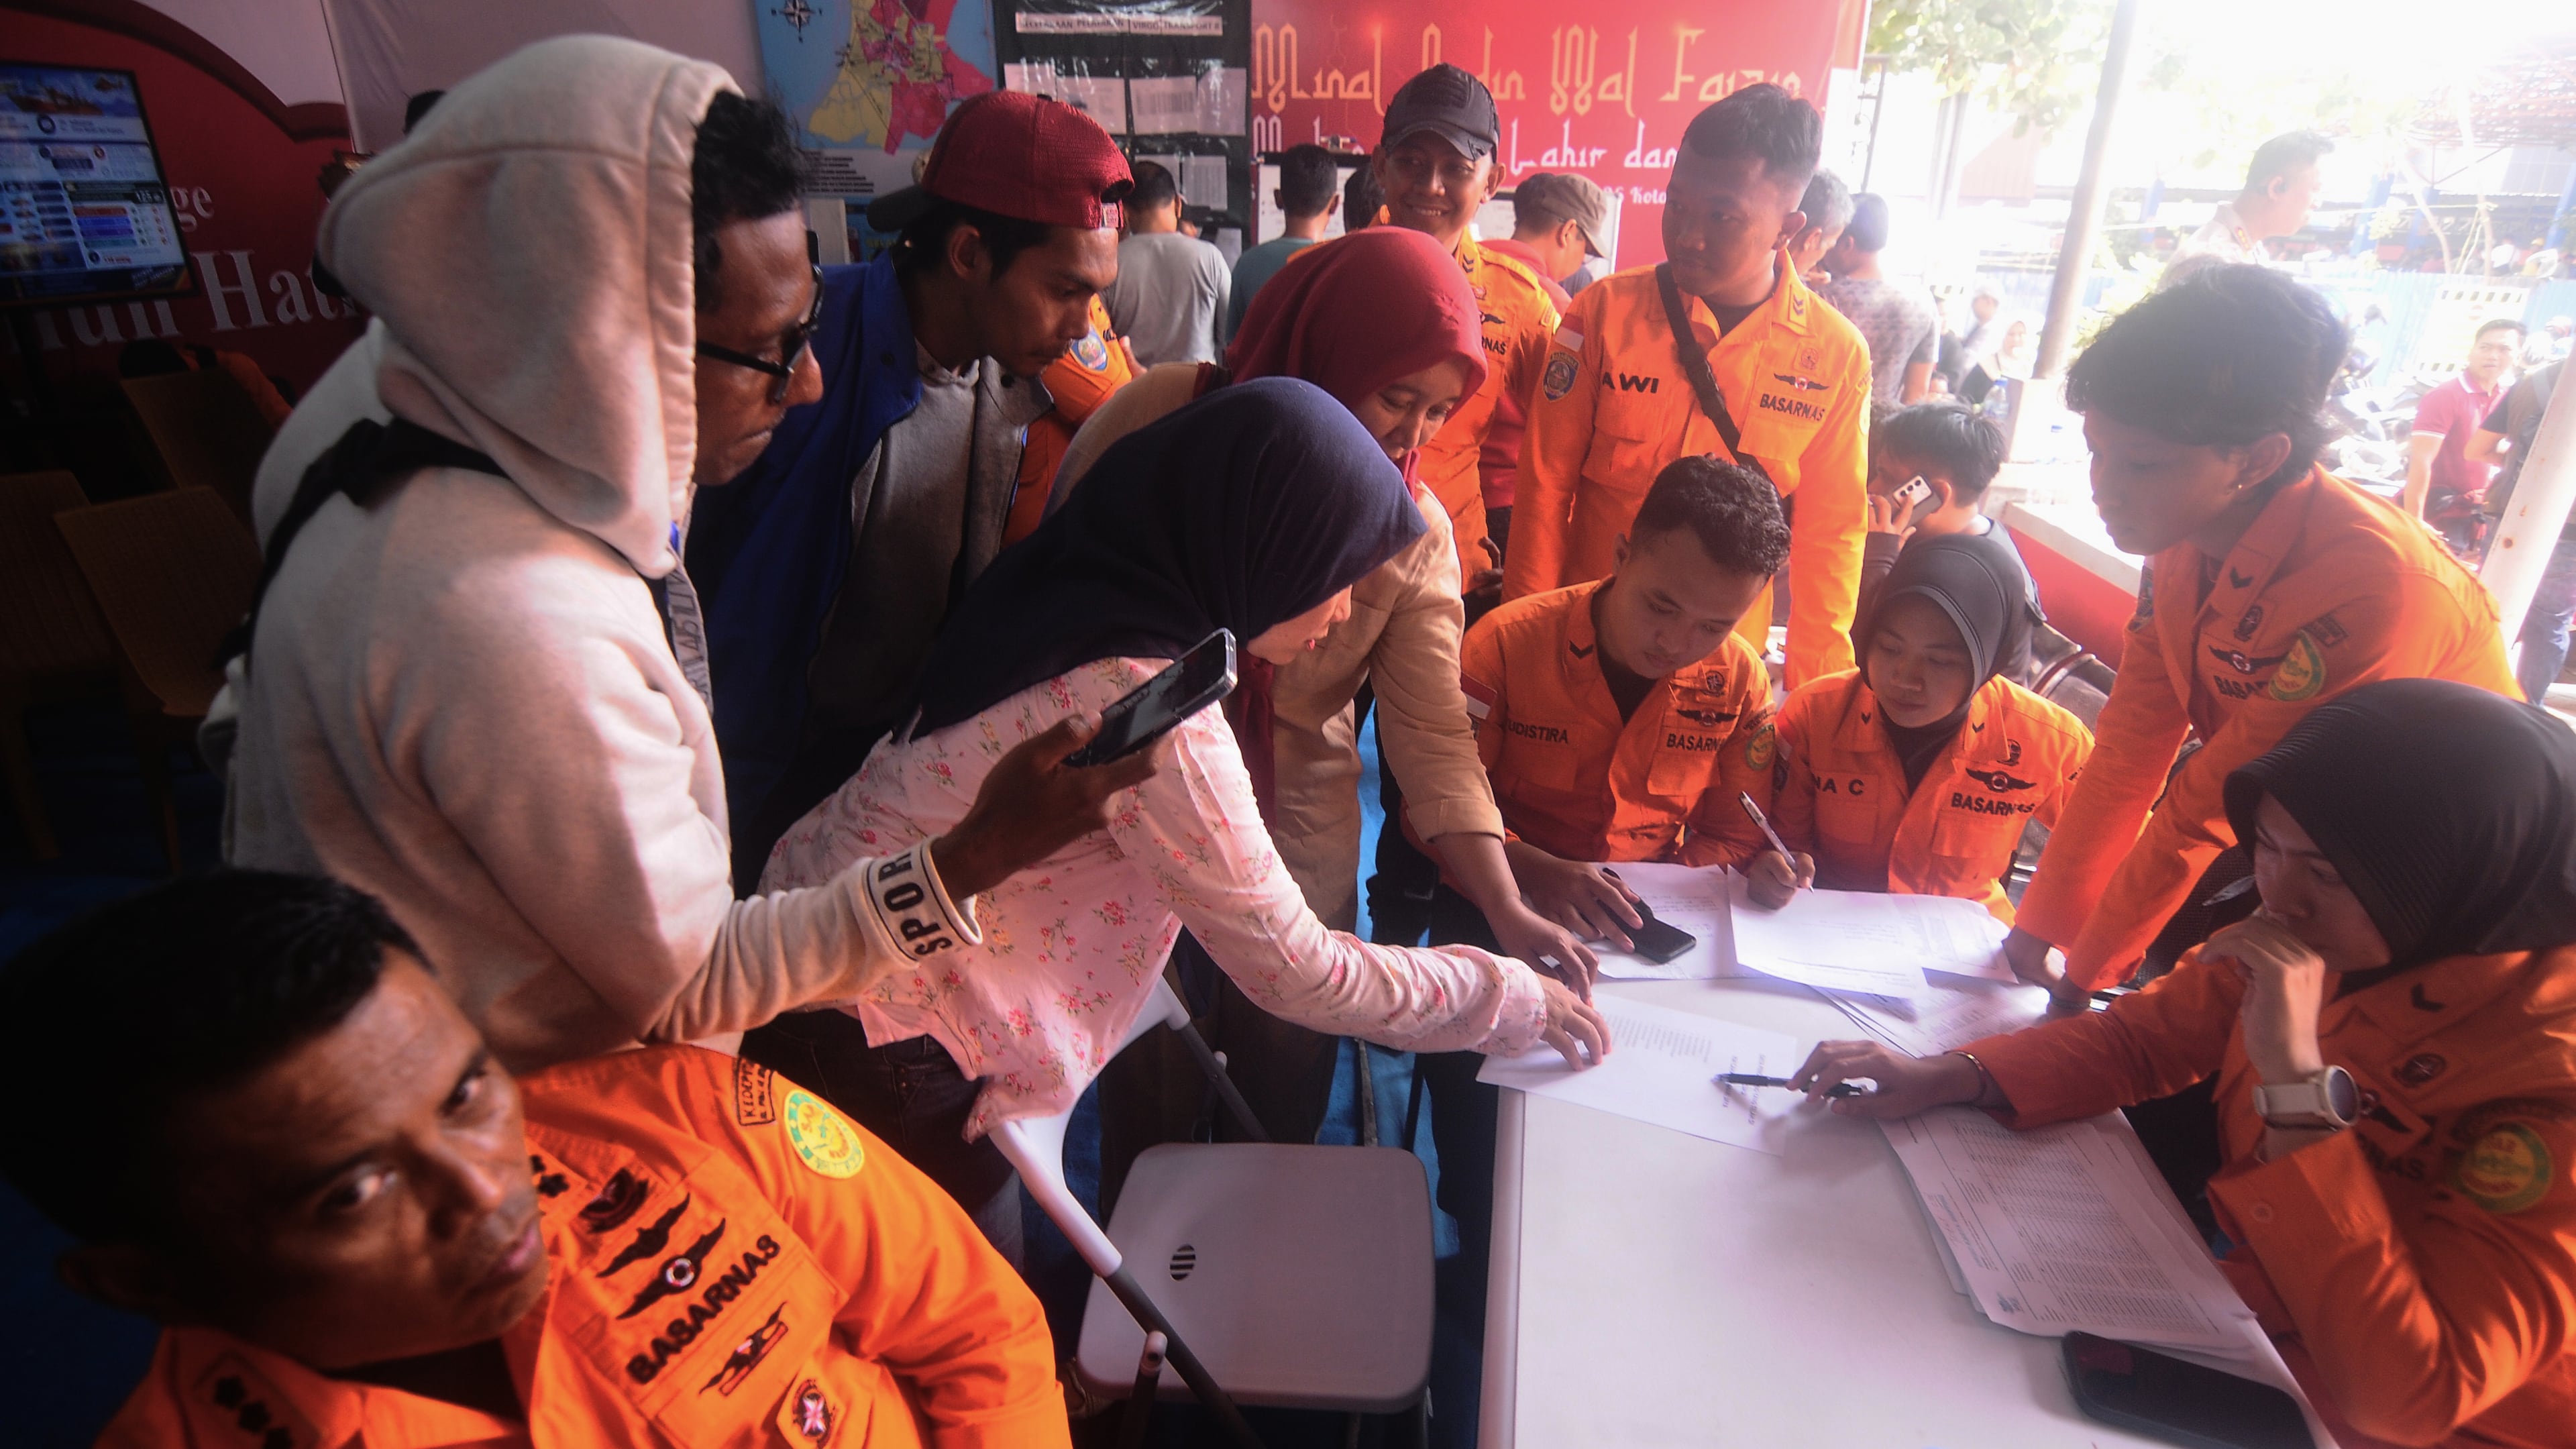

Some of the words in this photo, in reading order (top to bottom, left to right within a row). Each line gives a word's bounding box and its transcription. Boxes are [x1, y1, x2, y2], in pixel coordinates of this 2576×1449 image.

[1550, 23, 1638, 118] Wal
[1510, 117, 1608, 176] Lahir
[1760, 393, 1826, 421] BASARNAS
[1848, 779, 1865, 796] C
[625, 1234, 781, 1385] BASARNAS
